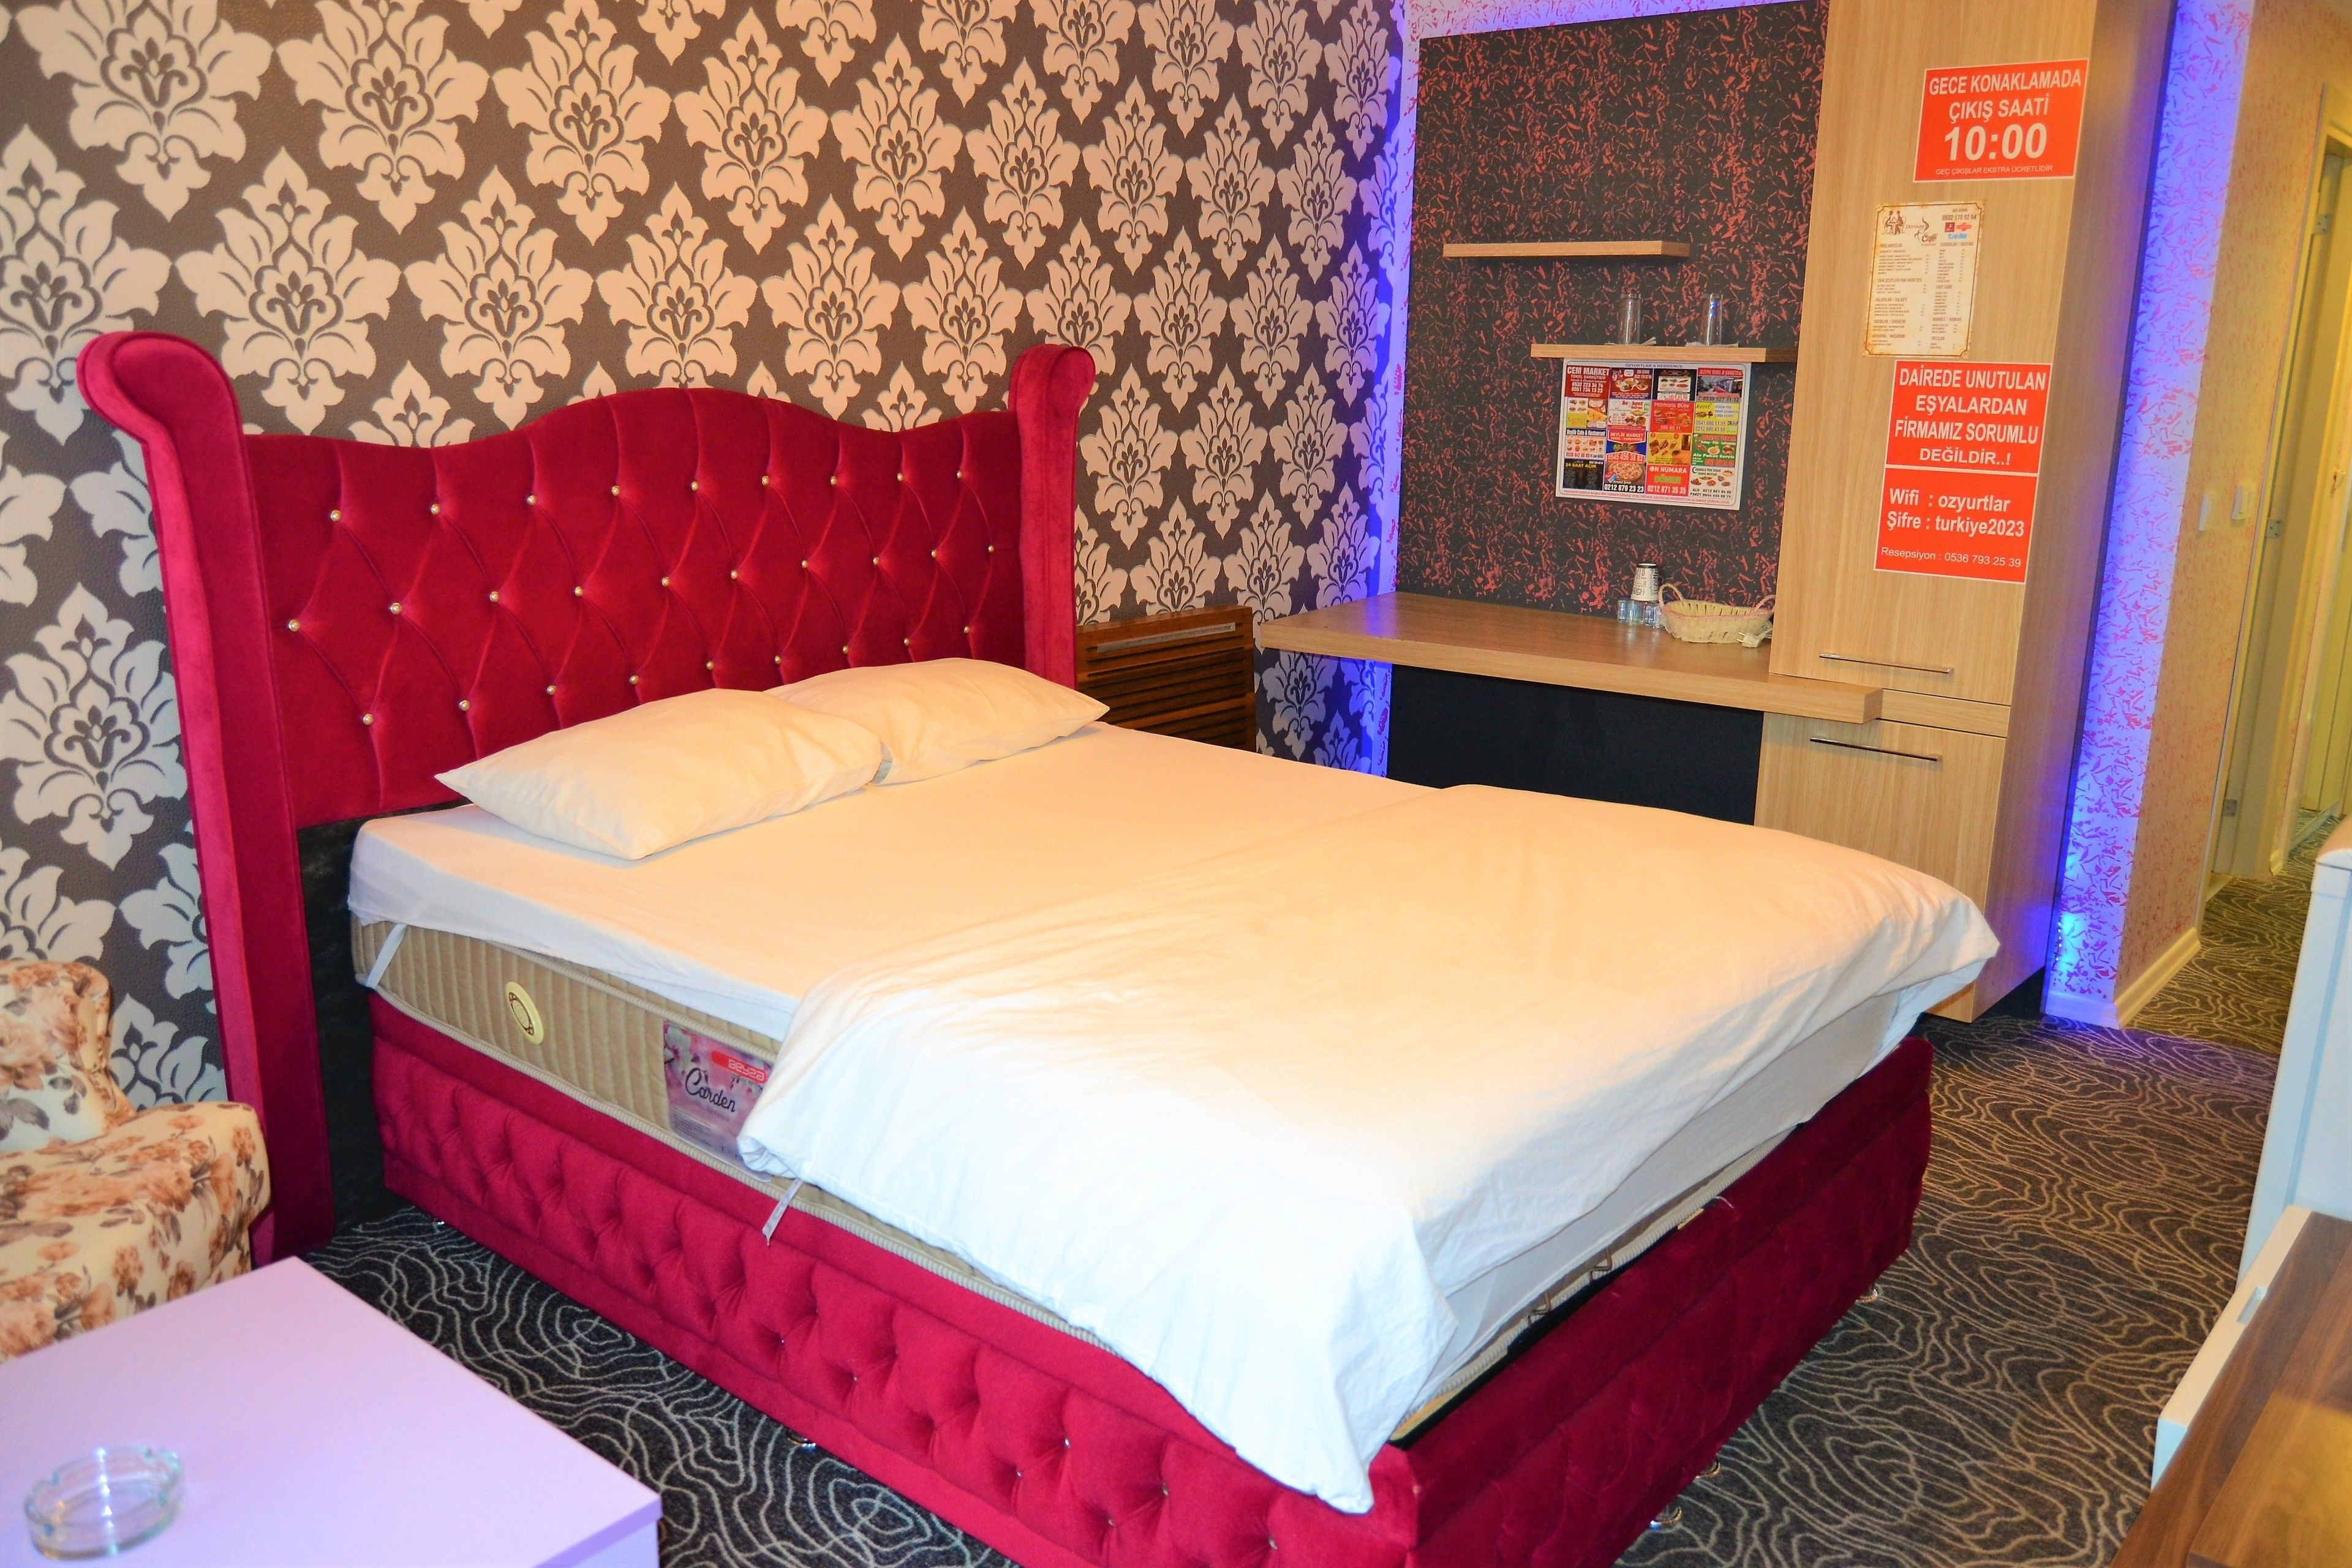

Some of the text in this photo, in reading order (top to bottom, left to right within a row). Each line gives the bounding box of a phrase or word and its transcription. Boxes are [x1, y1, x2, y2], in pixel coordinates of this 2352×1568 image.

[1929, 69, 2081, 95] GECE KONAKLAMADA
[1949, 93, 2049, 124] ÇIKIŞ SAATİ
[1944, 123, 2047, 161] 10:00
[1951, 167, 1982, 175] ÇIKIŞLAR
[1583, 368, 1610, 376] MARKET
[1899, 364, 2046, 390] DAİREDE UNUTULAN
[1916, 395, 2027, 415] EŞYALARDAN
[1894, 416, 2038, 444] FİRMAMIZ SORUMLU
[1890, 488, 1919, 505] Wifi
[1938, 495, 2011, 513] ozyurtlar
[1887, 511, 1921, 530] Şifre
[1936, 516, 2024, 537] turkiye2023
[1881, 547, 1936, 561] Resepsiyon
[1945, 552, 1969, 562] 0536
[1972, 555, 1990, 564] 793
[1993, 557, 2005, 566] 25
[2008, 558, 2021, 568] 39
